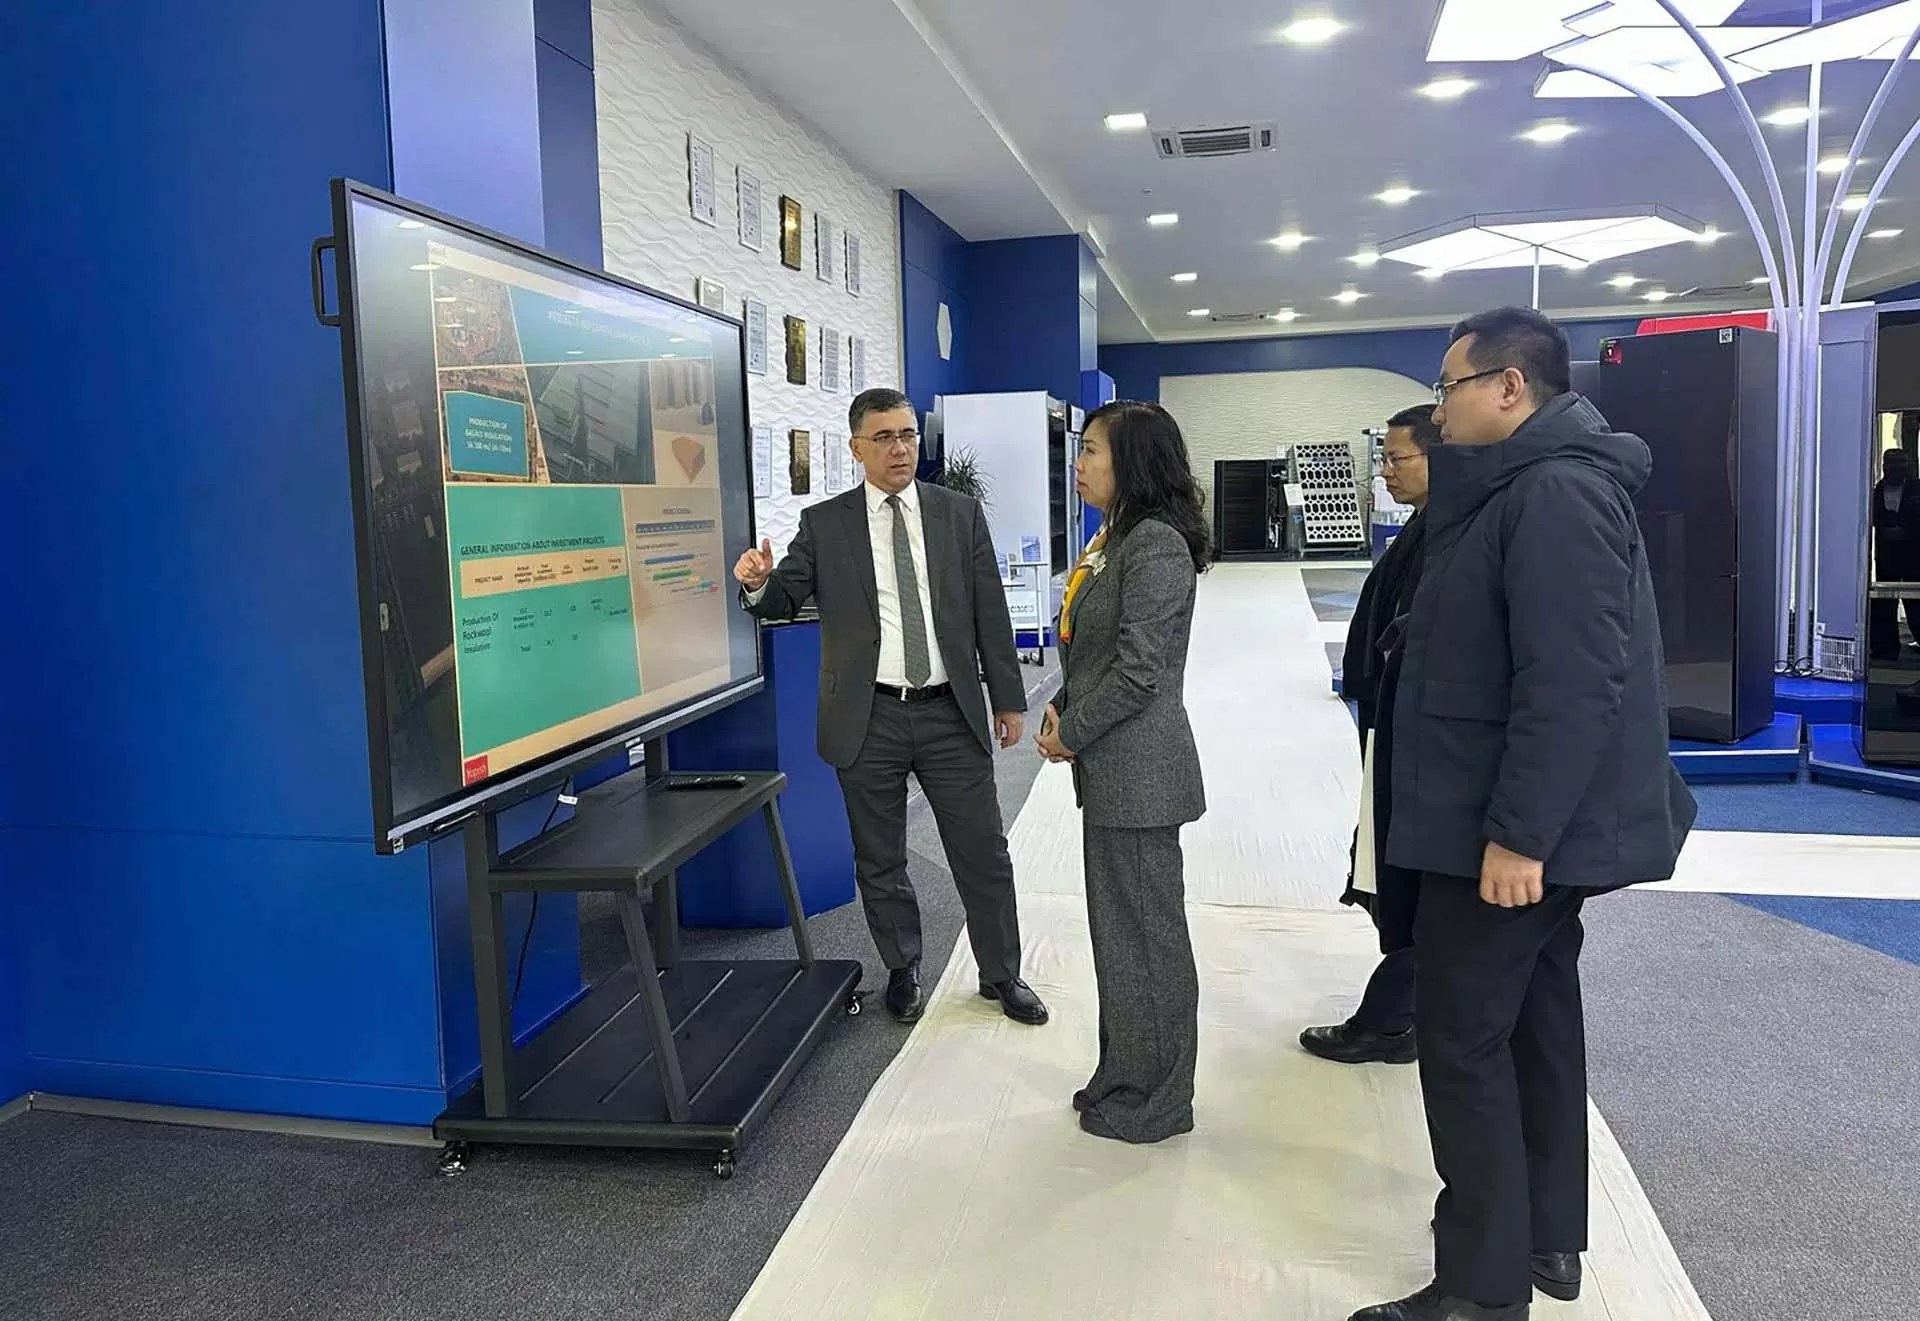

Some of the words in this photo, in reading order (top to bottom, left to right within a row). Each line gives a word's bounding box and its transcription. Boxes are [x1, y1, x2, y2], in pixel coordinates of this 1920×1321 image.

[461, 544, 489, 556] GENERAL
[490, 541, 531, 553] INFORMATION
[532, 539, 551, 549] ABOUT
[462, 615, 492, 627] Production
[462, 627, 492, 641] Rockwool
[463, 642, 491, 654] Insulation
